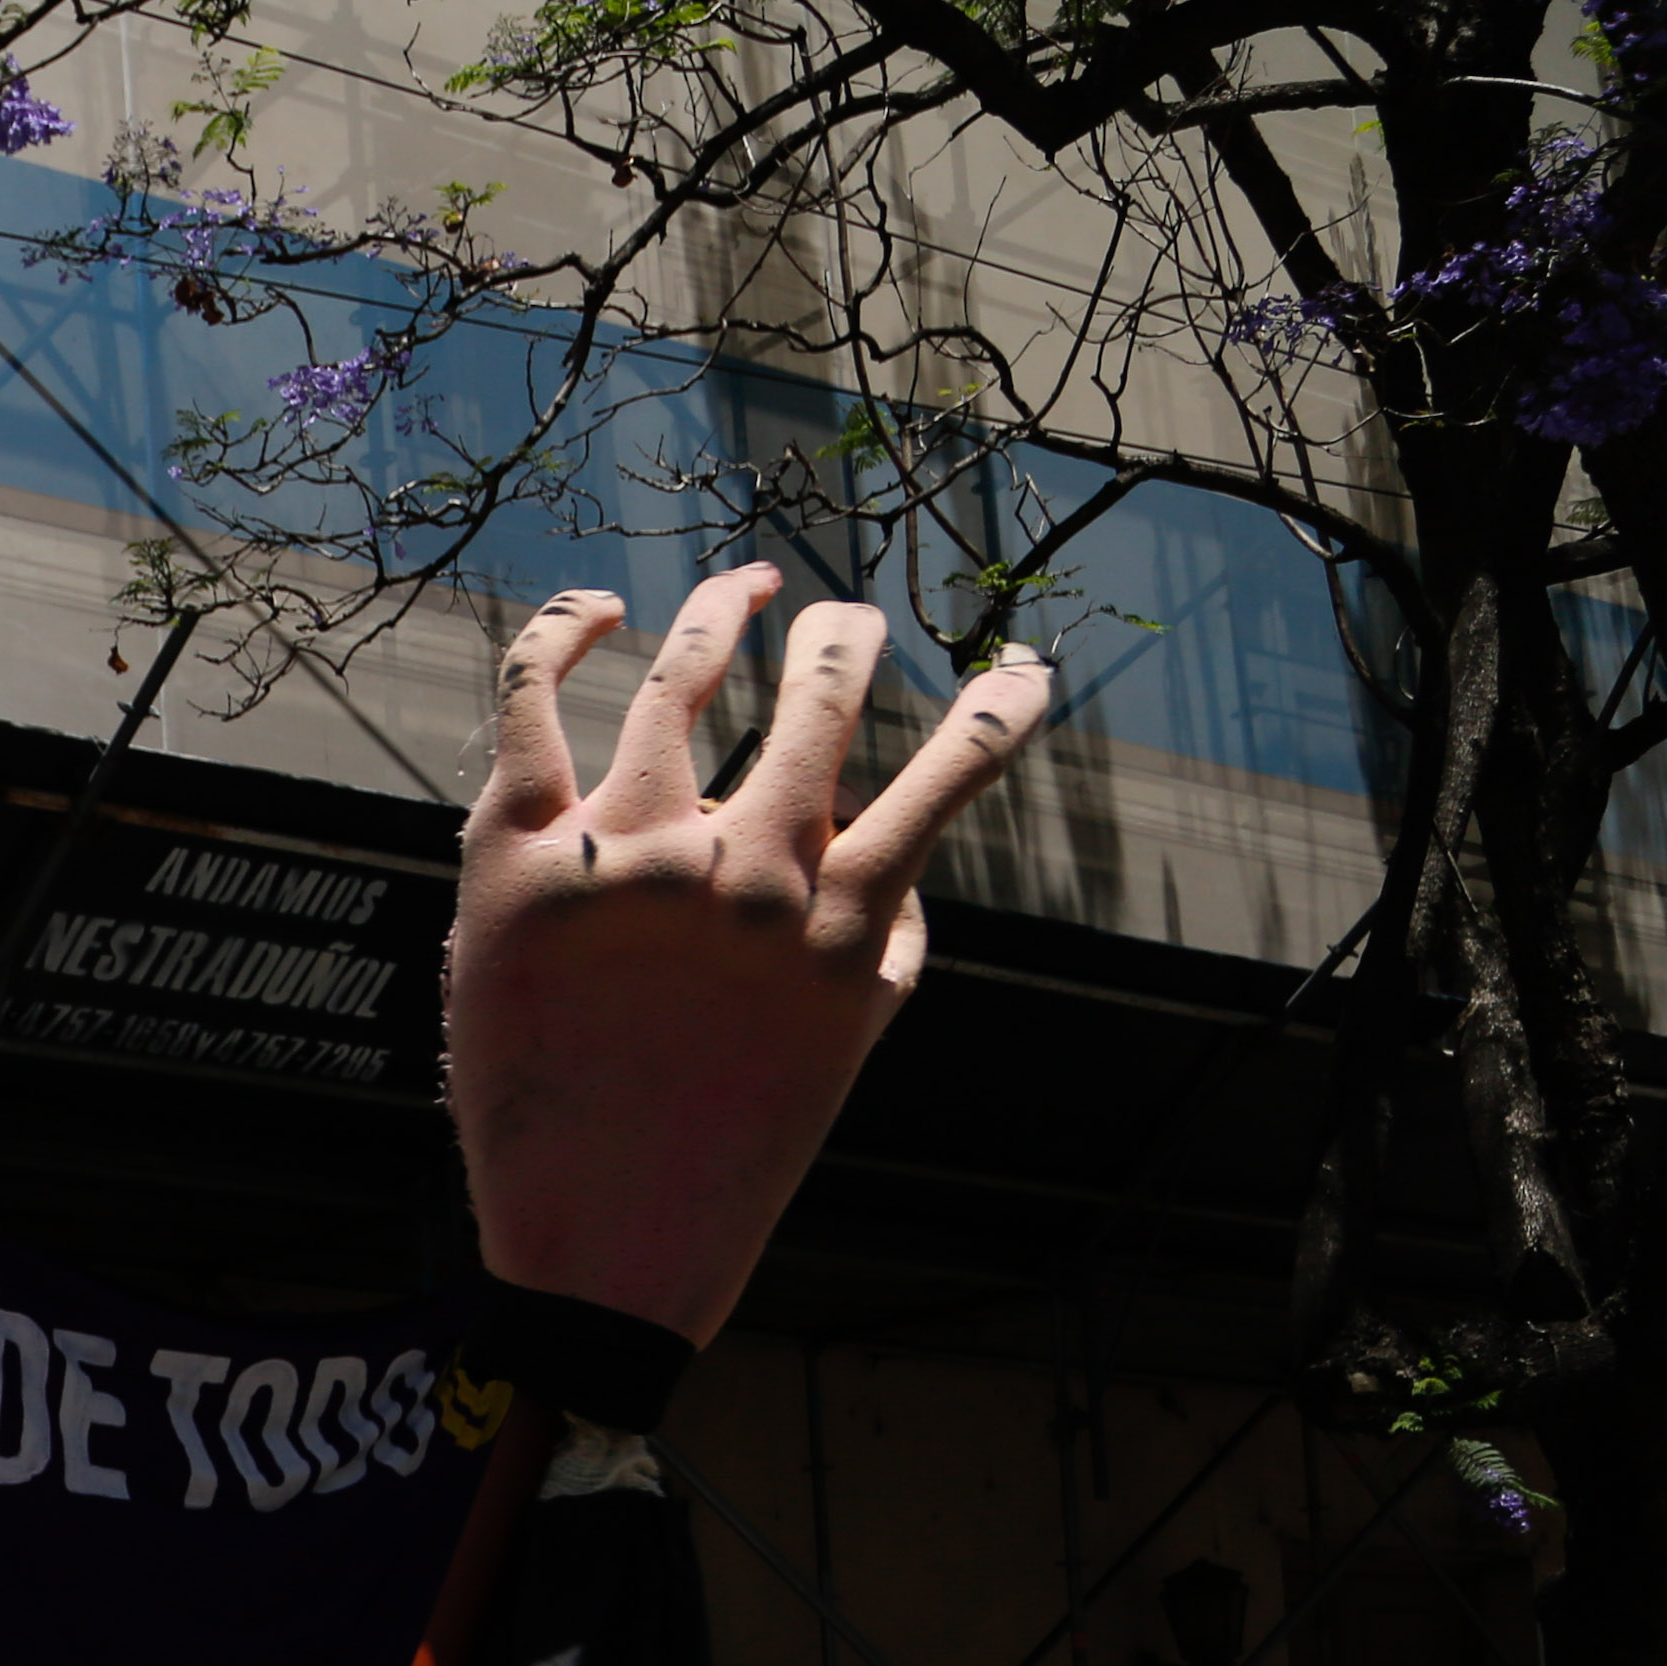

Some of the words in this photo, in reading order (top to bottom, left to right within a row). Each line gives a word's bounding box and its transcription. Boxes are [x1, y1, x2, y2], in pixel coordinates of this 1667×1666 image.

[145, 846, 389, 926] ANDAMIOS
[23, 910, 399, 1020] NESTRADUÑOL
[149, 1346, 440, 1513] TODO
